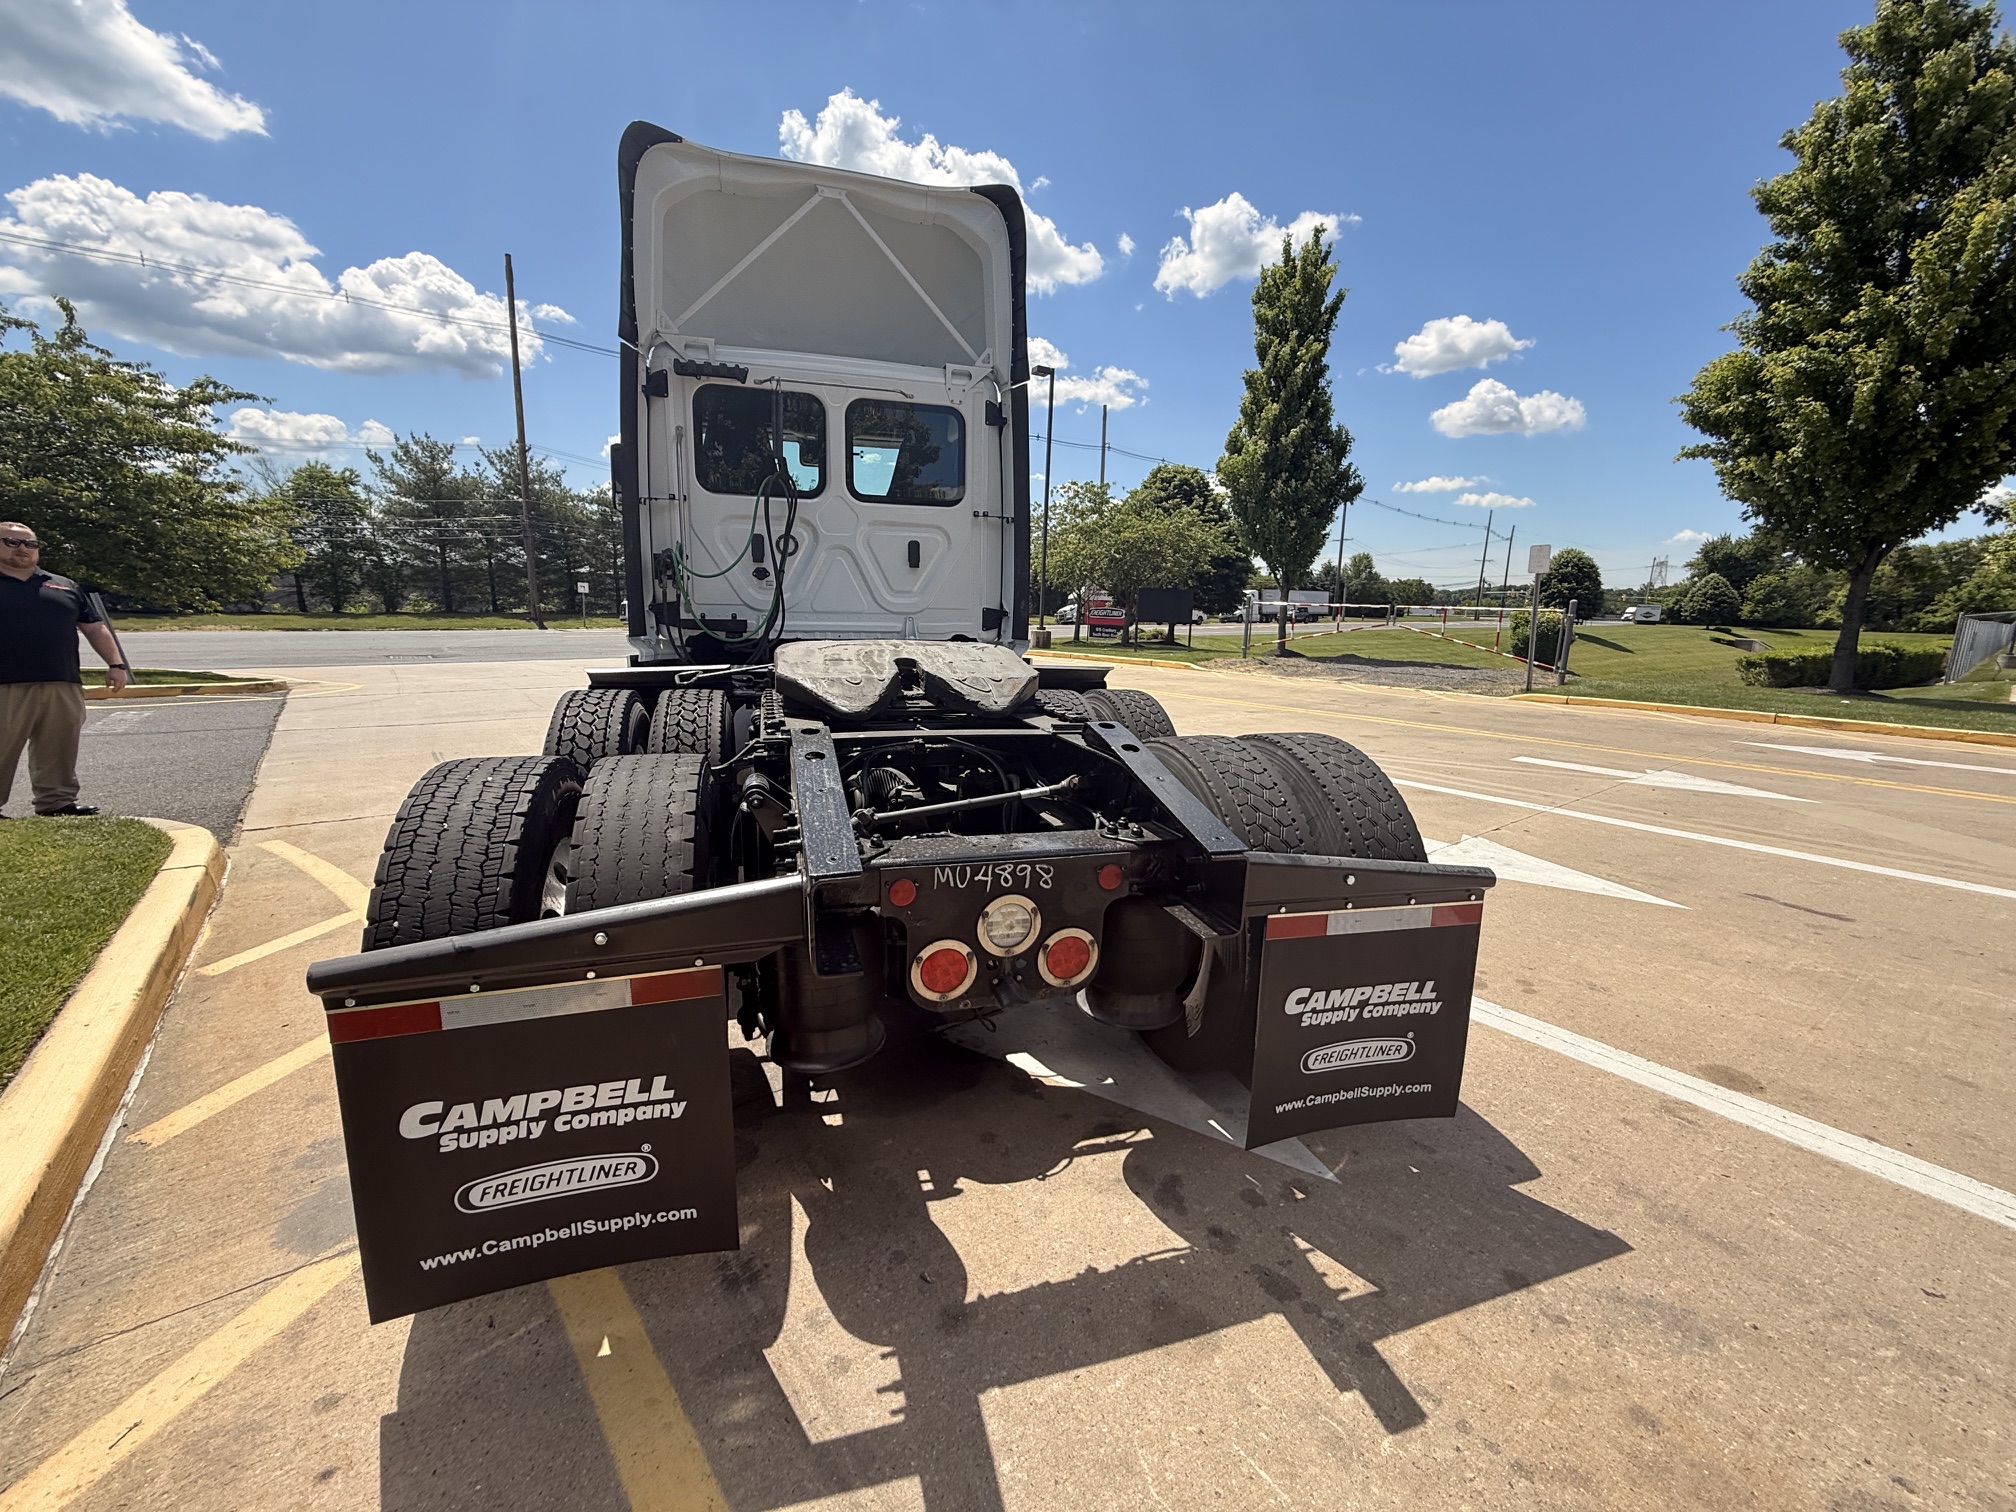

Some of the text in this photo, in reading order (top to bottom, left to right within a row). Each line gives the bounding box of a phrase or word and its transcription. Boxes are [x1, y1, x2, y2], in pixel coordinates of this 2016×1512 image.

[1284, 980, 1438, 1015] CAMPBELL
[1300, 1000, 1443, 1027] Supply Company
[1311, 1043, 1405, 1067] FREIGHTLINER
[399, 1075, 676, 1139] CAMPBELL
[1274, 1082, 1433, 1114] www.CampbellSupply.com
[439, 1101, 688, 1153] Supply Company
[478, 1160, 639, 1203] FREIGHTLINER
[419, 1206, 698, 1271] www.CampbellSupply.com
